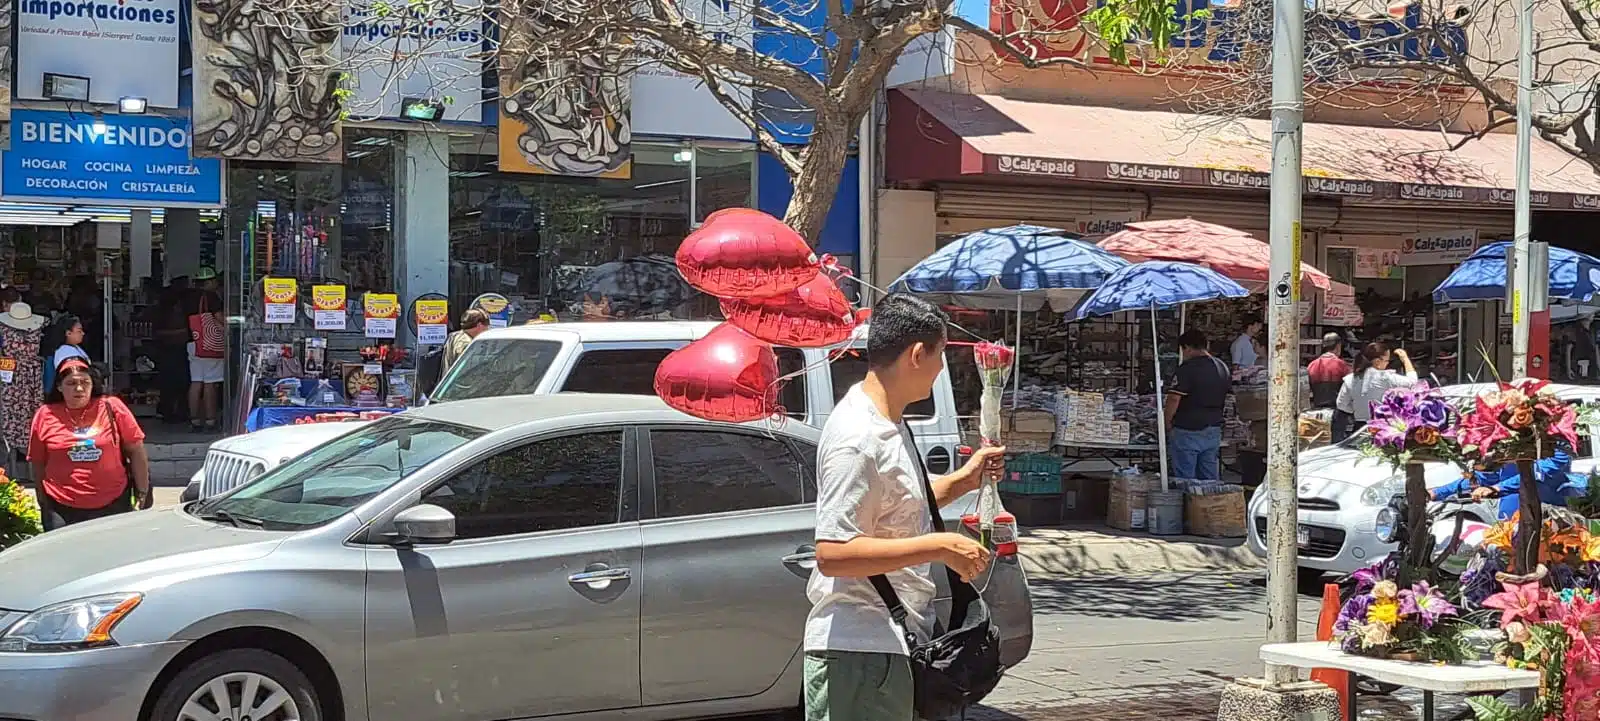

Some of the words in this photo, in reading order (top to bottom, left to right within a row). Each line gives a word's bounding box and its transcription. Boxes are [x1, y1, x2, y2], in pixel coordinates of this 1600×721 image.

[20, 24, 49, 35] Variedad
[56, 28, 80, 37] Precios
[82, 30, 100, 39] Bajos
[135, 34, 156, 42] Desde
[21, 158, 68, 170] HOGAR
[84, 161, 133, 174] COCINA
[146, 164, 201, 176] LIMPIEZA
[1011, 156, 1076, 174] Calzzapato
[1119, 164, 1180, 181] Calzzapato
[26, 177, 108, 191] DECORACIÓN
[121, 181, 196, 194] CRISTALERÍA
[1222, 171, 1270, 187] Calzzapa
[1318, 179, 1374, 195] Calzzapato
[1410, 184, 1463, 200] Calzzapato
[1414, 236, 1473, 251] Calzzapato
